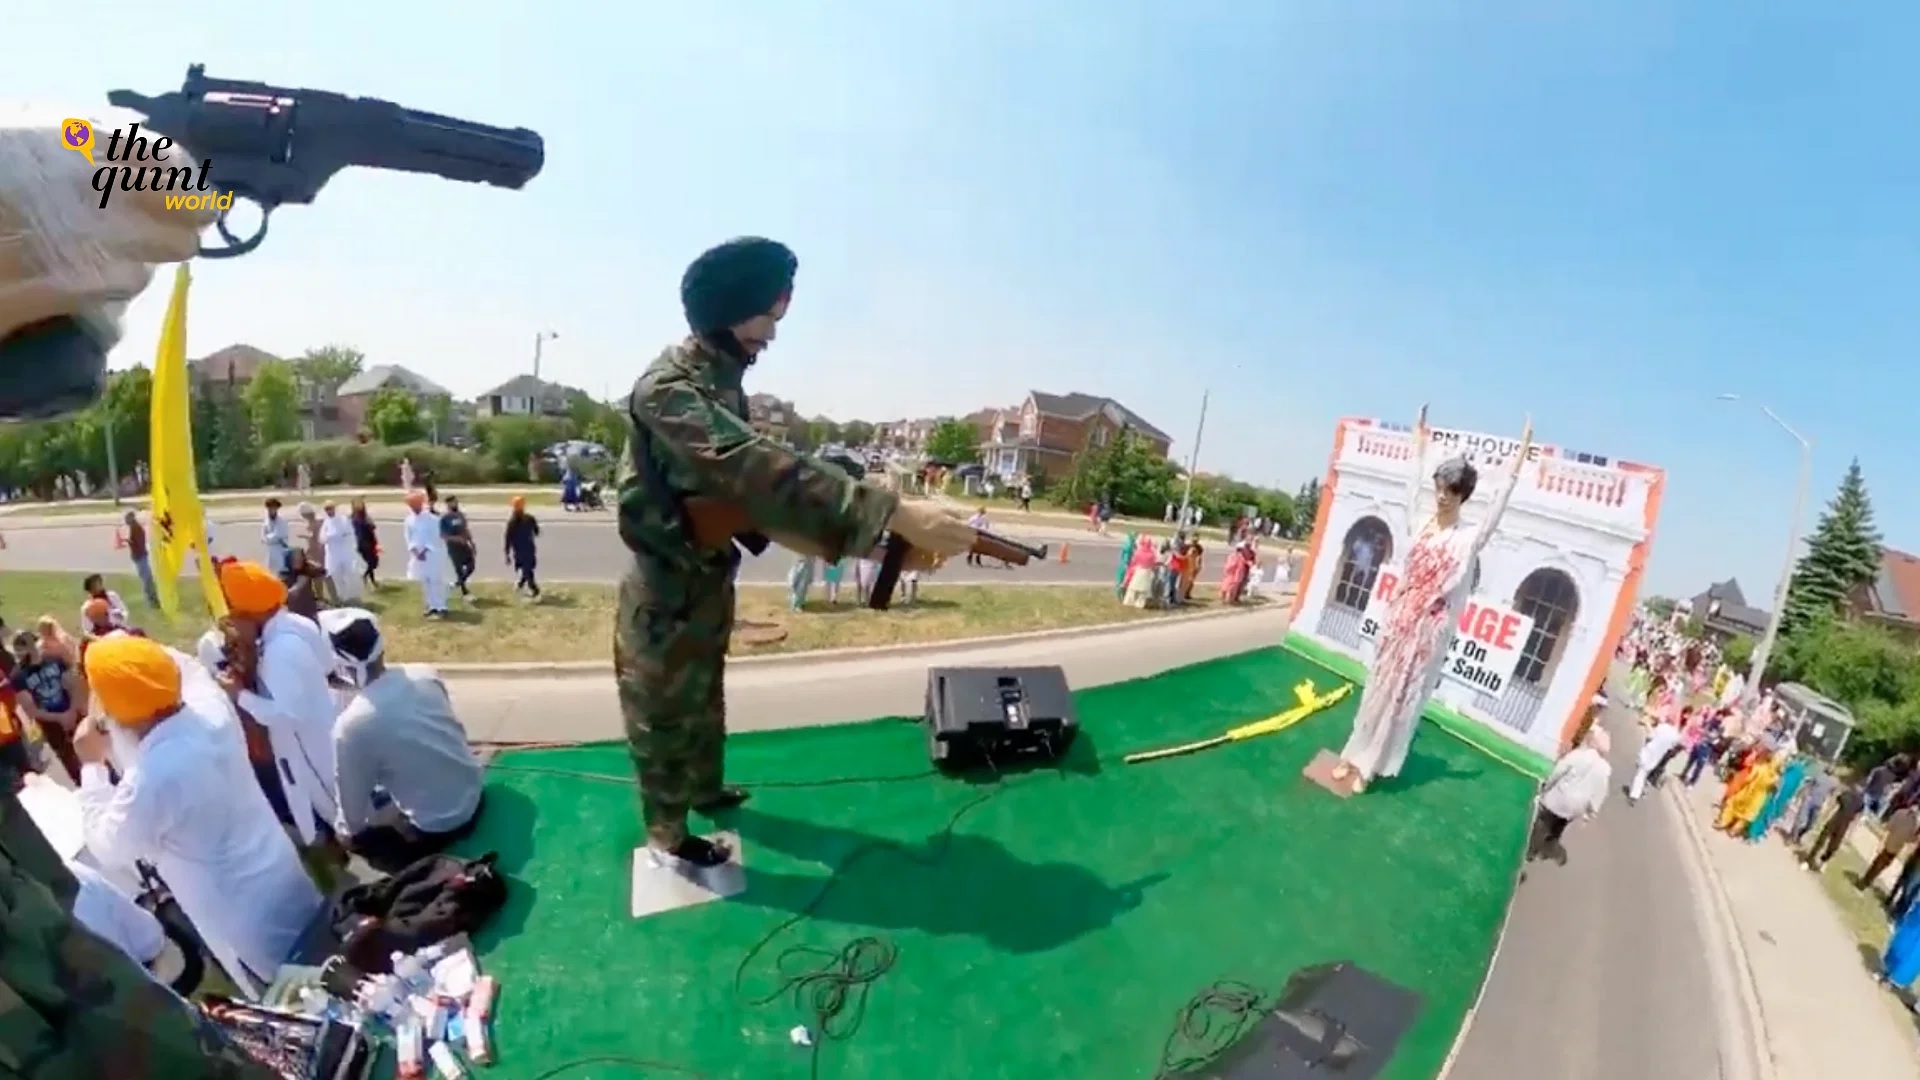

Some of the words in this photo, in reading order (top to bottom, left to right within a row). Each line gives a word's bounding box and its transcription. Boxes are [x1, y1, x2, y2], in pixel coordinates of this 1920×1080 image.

[1432, 430, 1460, 448] PM
[1463, 640, 1488, 663] On
[1452, 657, 1502, 692] Sahib
